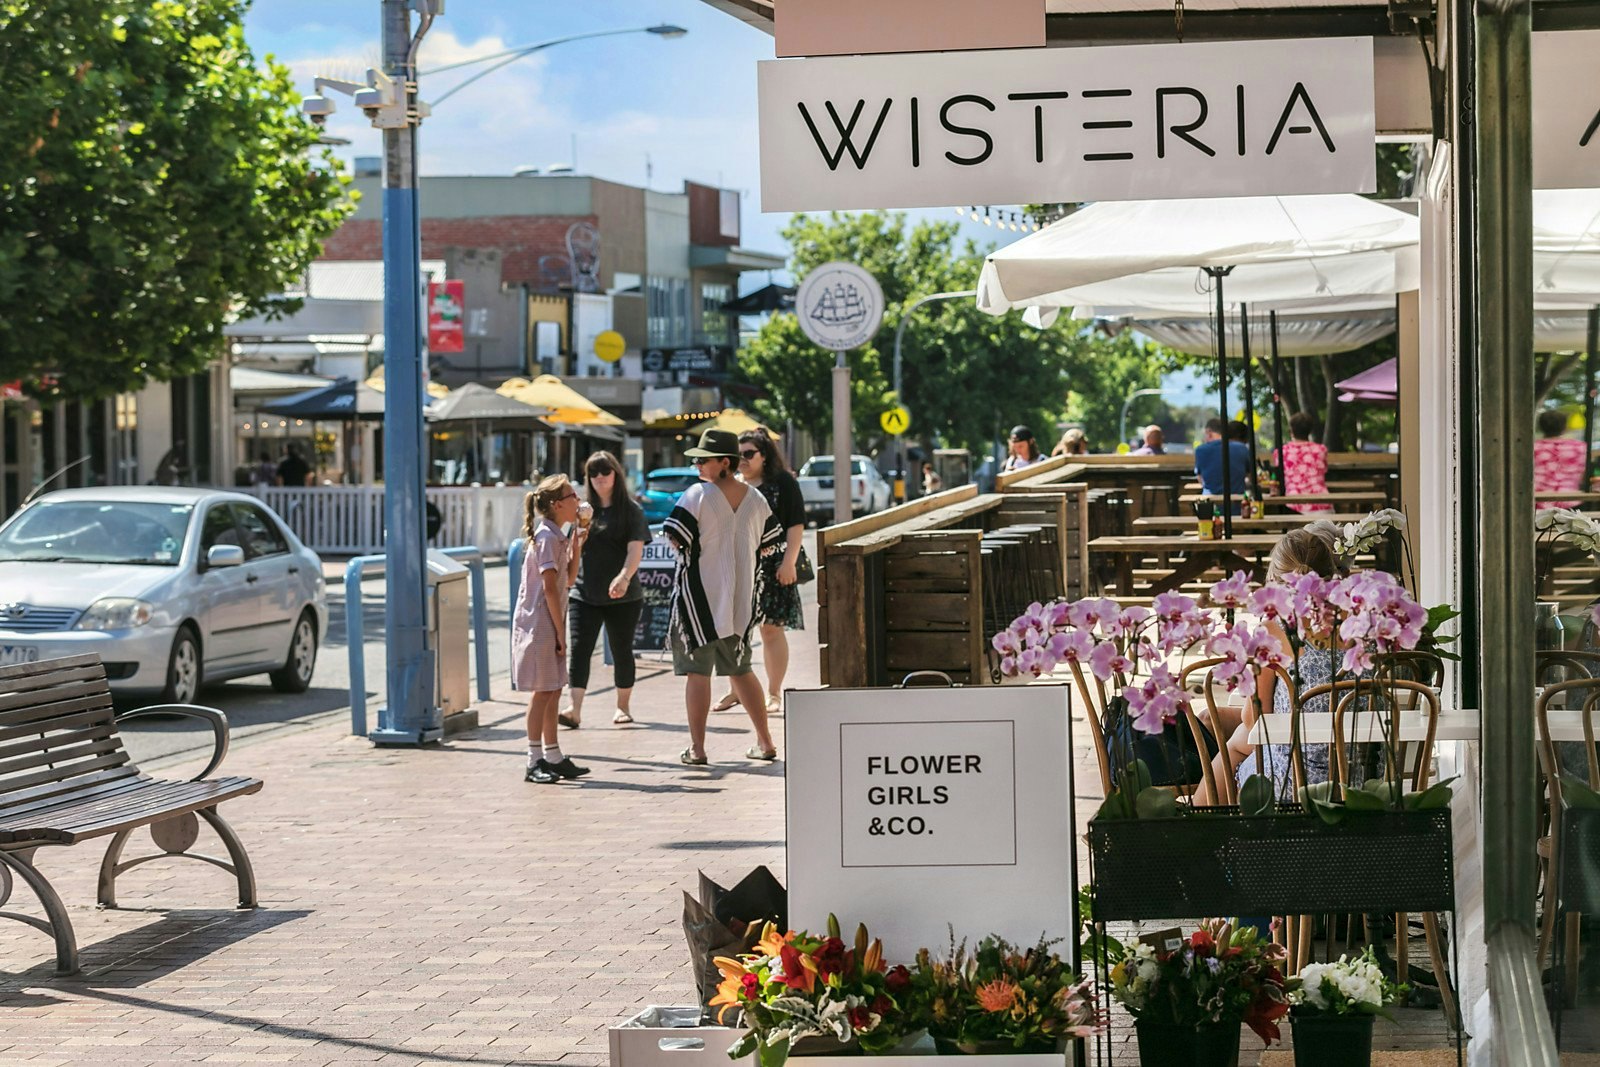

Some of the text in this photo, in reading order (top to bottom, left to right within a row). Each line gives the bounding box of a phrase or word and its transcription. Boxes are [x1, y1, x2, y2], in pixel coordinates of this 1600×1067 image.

[797, 81, 1337, 171] WISTERIA
[867, 754, 982, 775] FLOWER
[867, 785, 949, 806] GIRLS
[868, 815, 934, 837] &CO.
